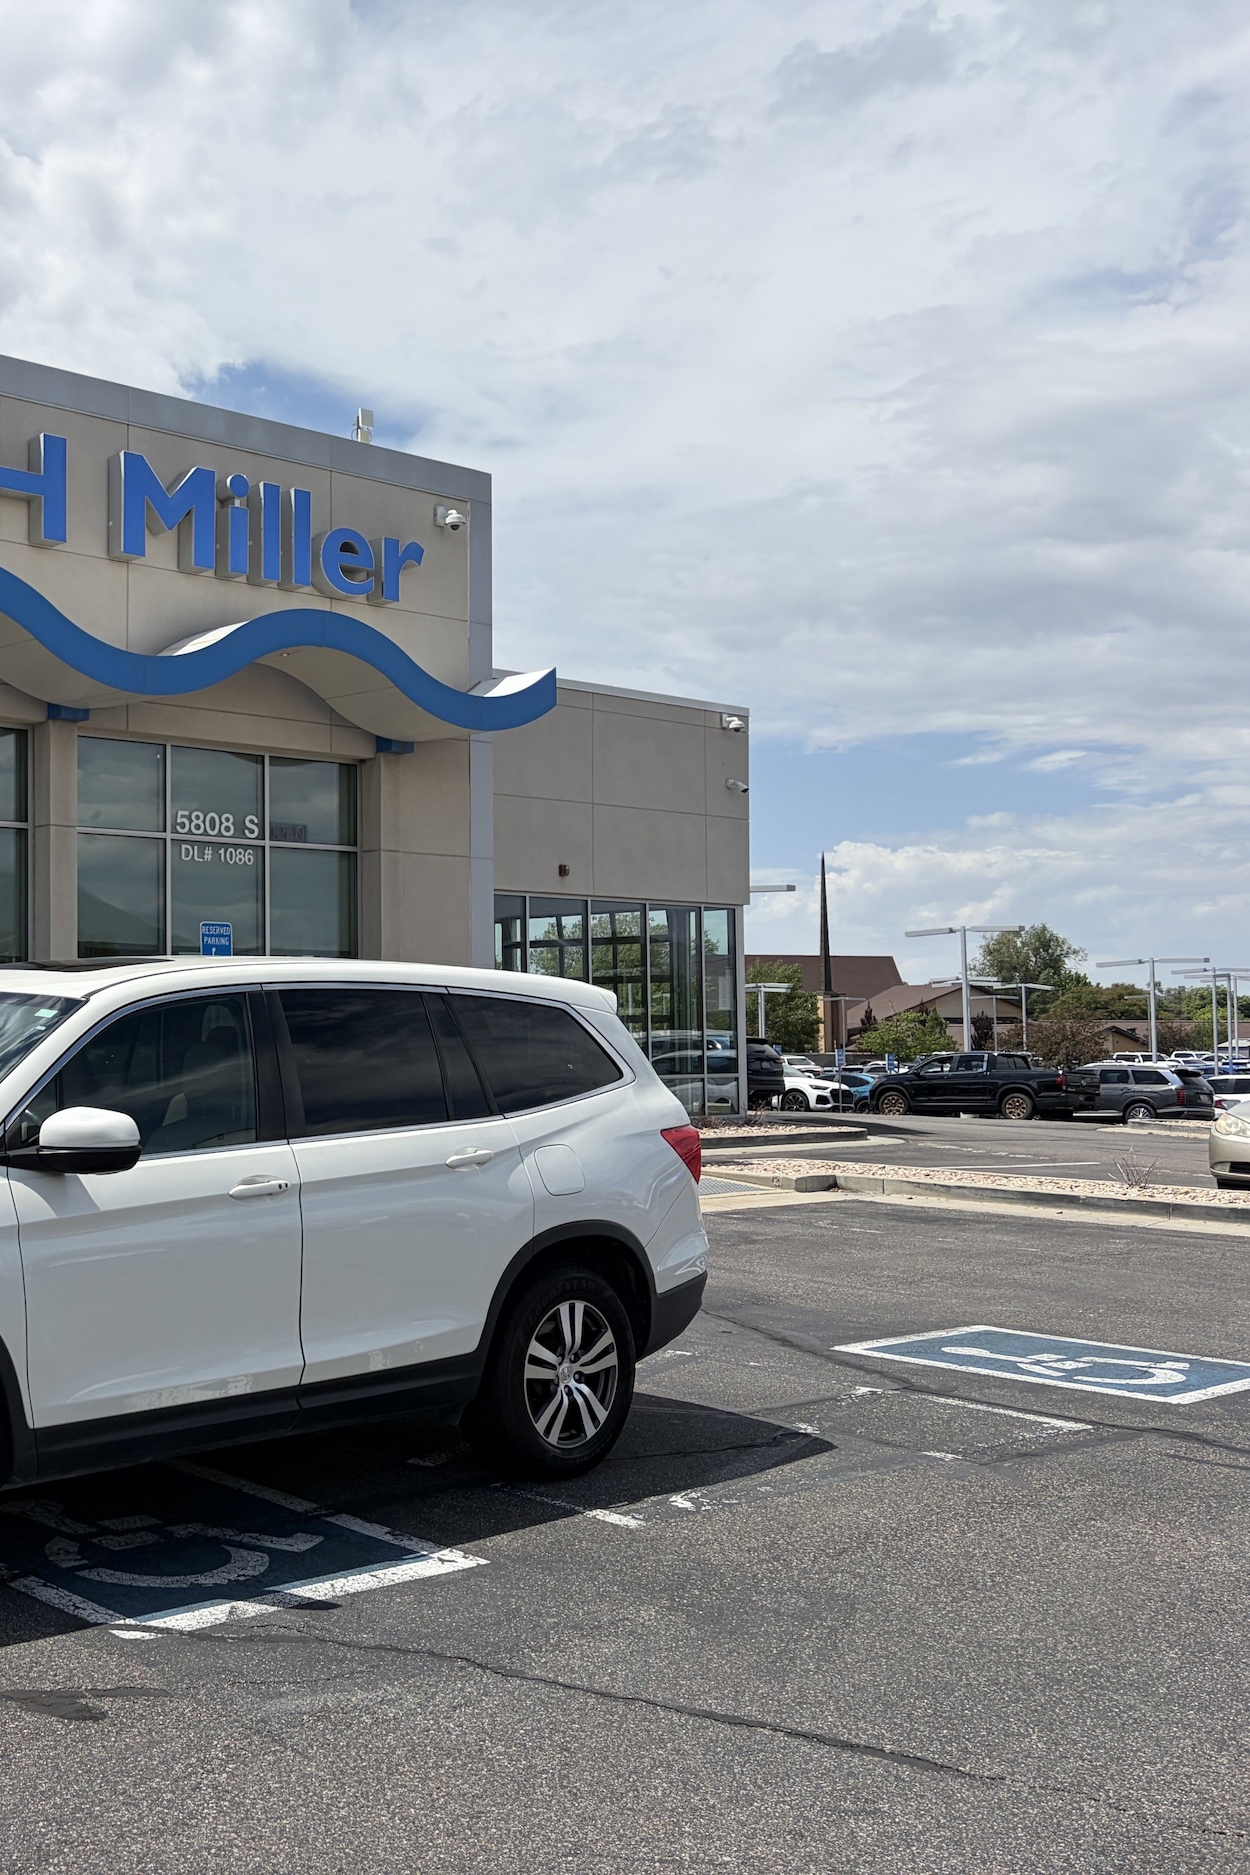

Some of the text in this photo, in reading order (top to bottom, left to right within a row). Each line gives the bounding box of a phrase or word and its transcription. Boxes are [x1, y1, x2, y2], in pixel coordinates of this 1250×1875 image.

[108, 449, 425, 604] Miller
[176, 810, 259, 838] 5808 S
[181, 844, 254, 865] DL# 1086
[202, 925, 230, 935] RESERVED
[203, 936, 229, 946] PARKING
